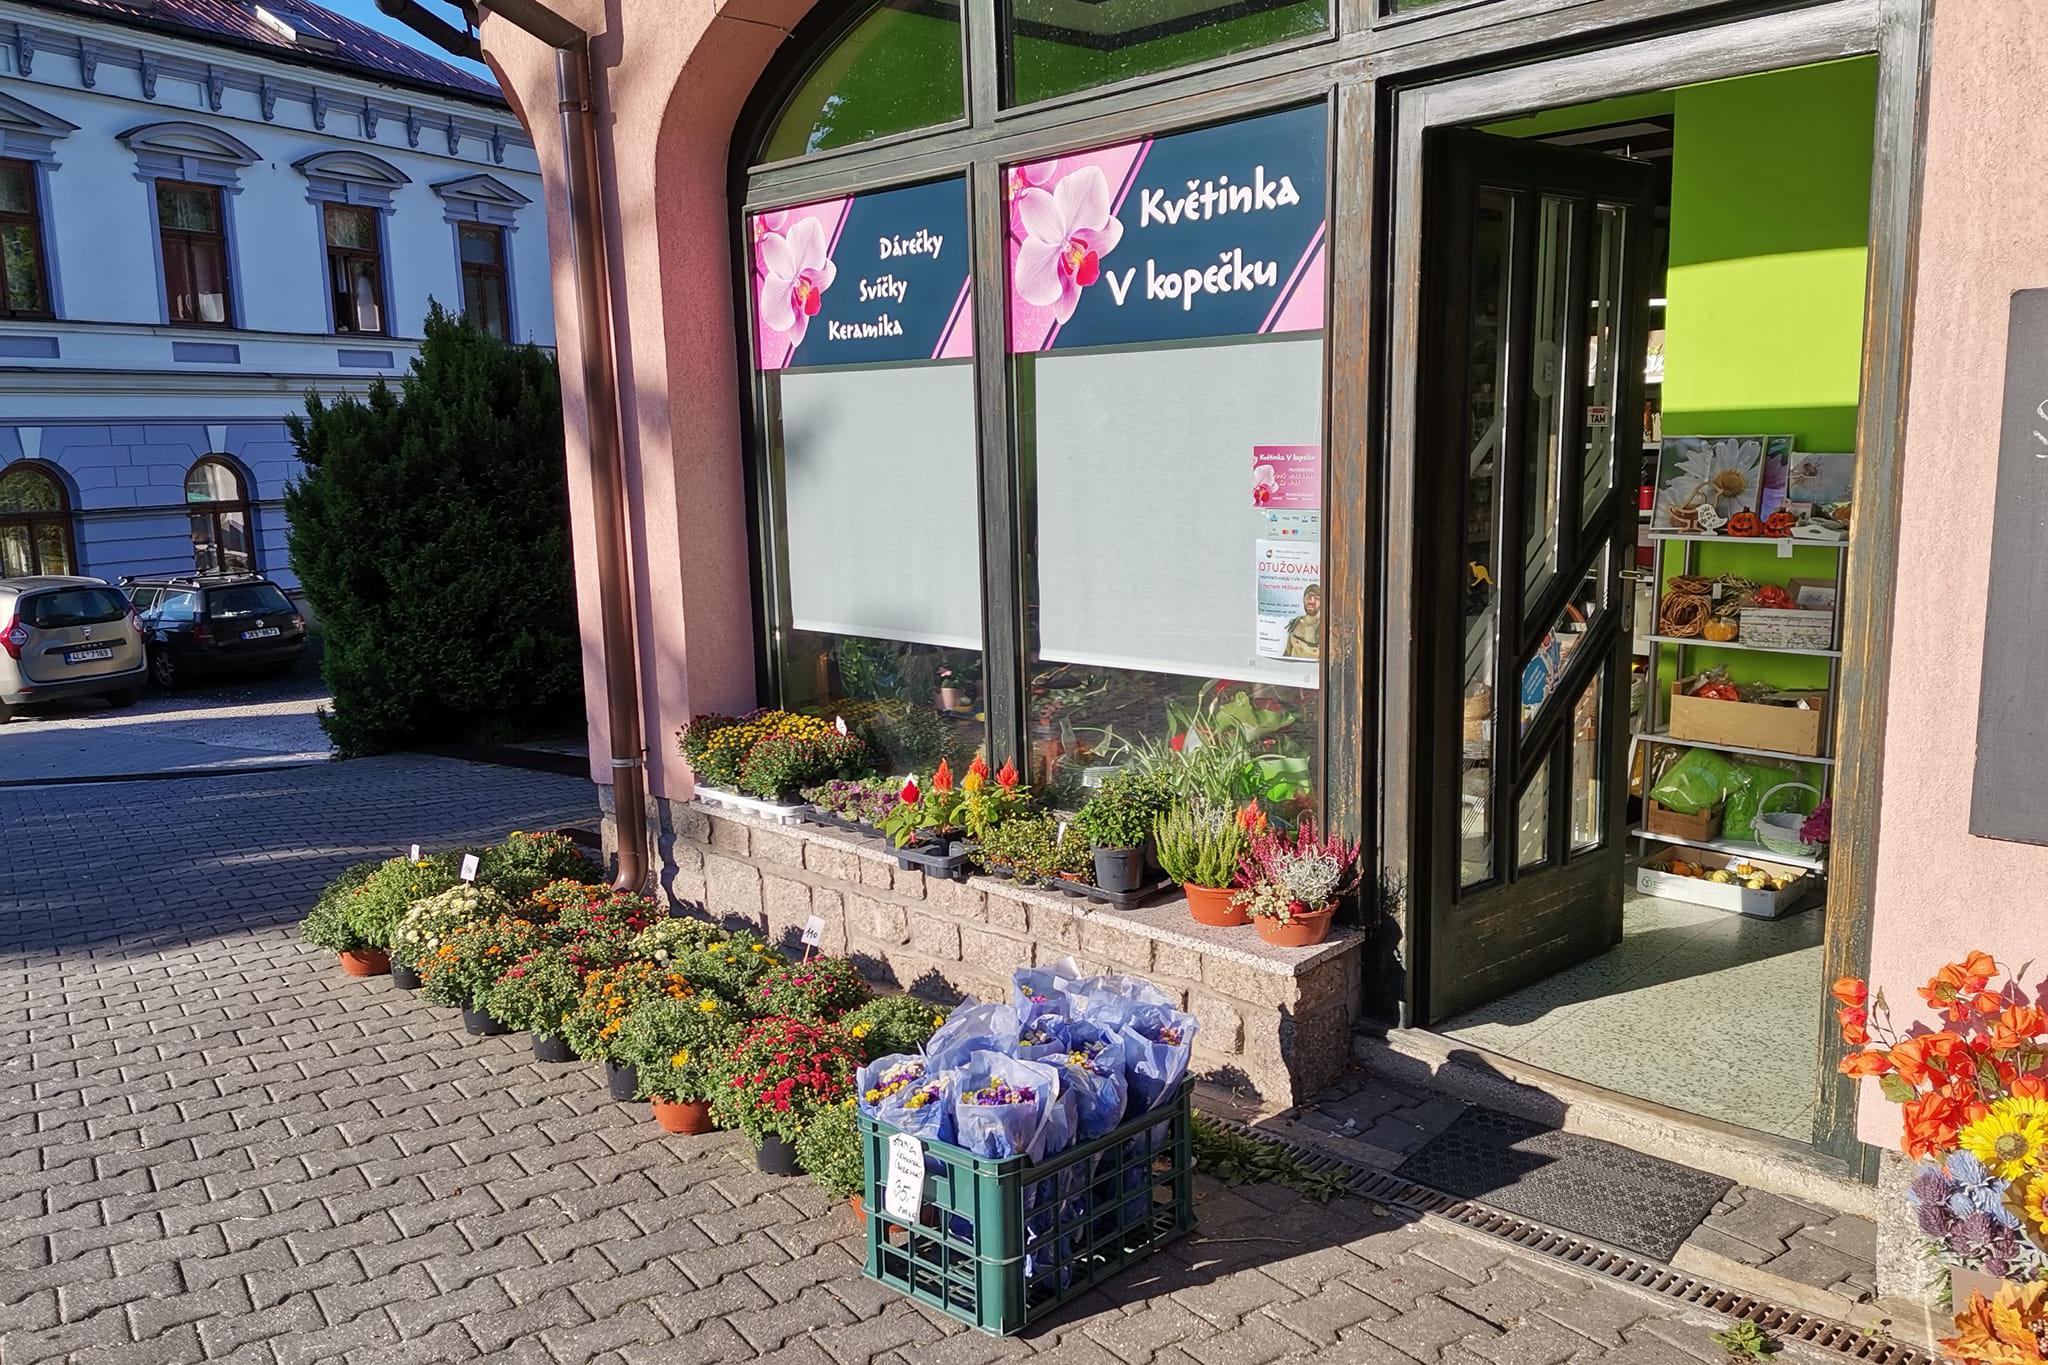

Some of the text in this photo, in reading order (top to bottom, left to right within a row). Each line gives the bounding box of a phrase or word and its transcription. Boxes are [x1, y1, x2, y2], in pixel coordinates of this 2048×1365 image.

[1141, 165, 1300, 227] Květinka
[879, 228, 943, 259] Dárečky
[859, 274, 907, 303] Svíčky
[1106, 248, 1277, 311] V kopečku
[829, 313, 903, 340] Keramika
[1590, 414, 1606, 424] TAM
